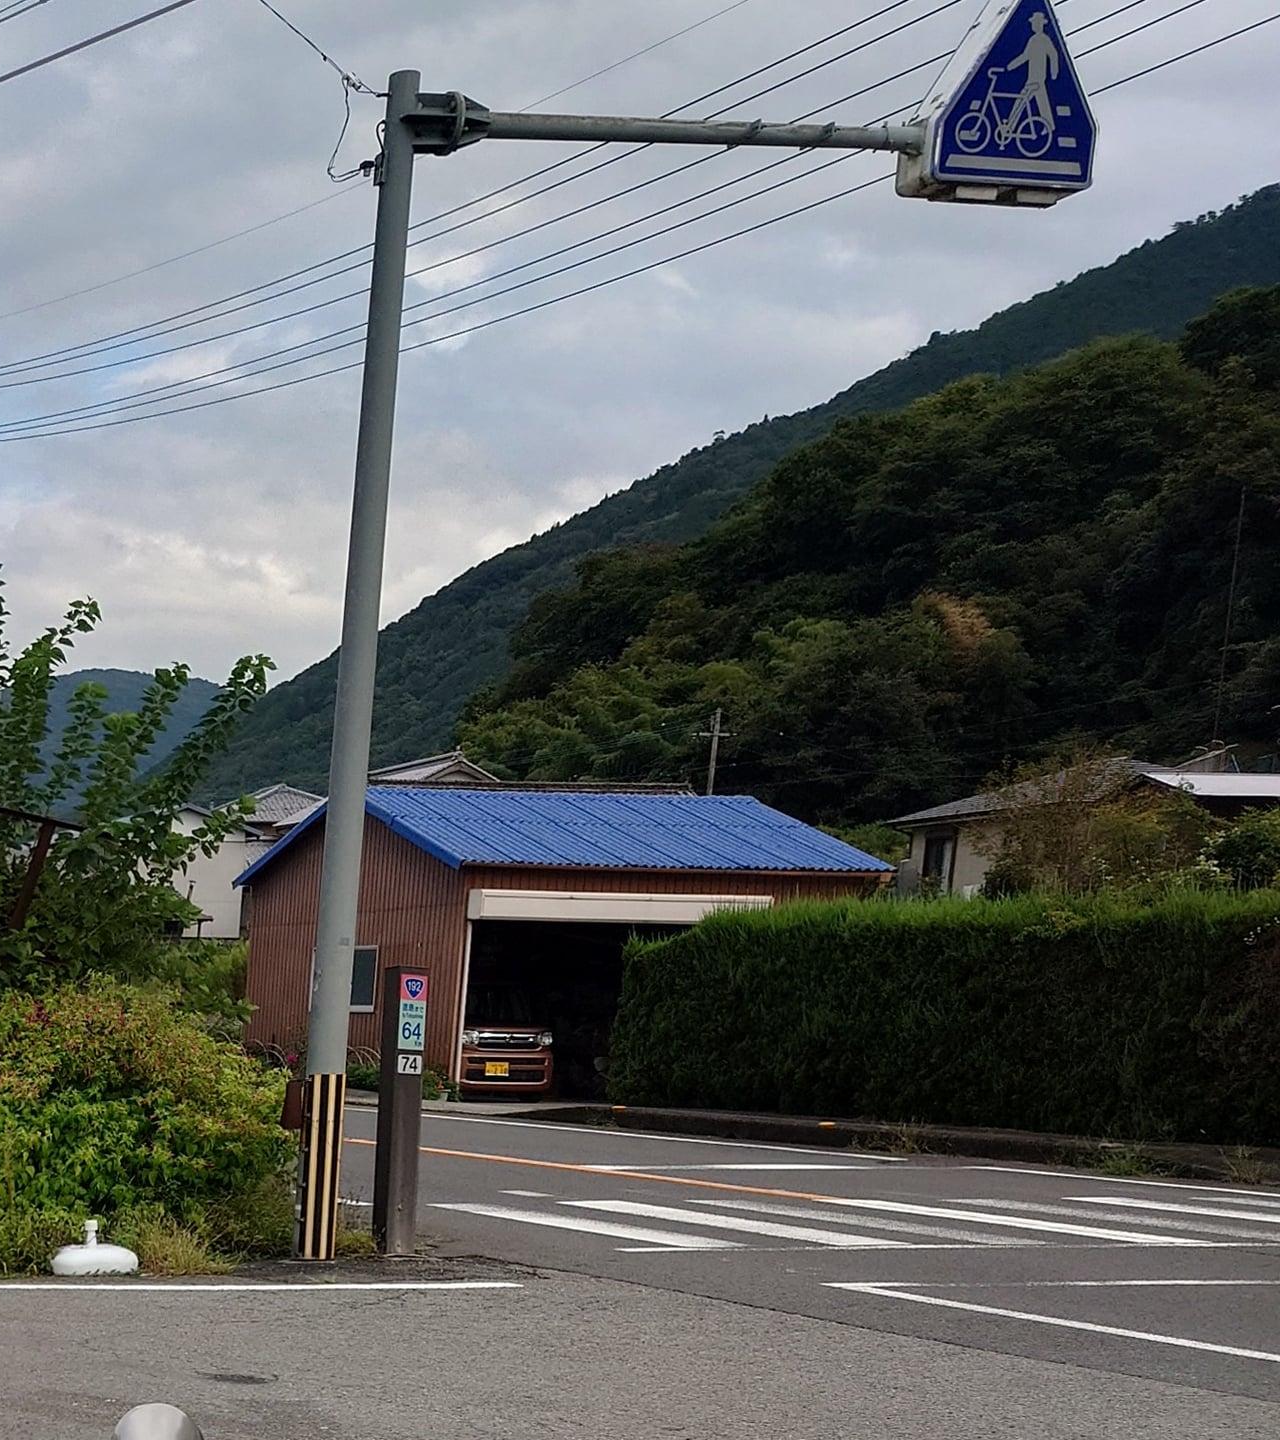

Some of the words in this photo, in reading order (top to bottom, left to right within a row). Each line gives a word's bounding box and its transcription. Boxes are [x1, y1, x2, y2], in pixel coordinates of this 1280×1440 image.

[407, 981, 422, 992] 192
[402, 1022, 422, 1040] 64
[401, 1056, 418, 1073] 74
